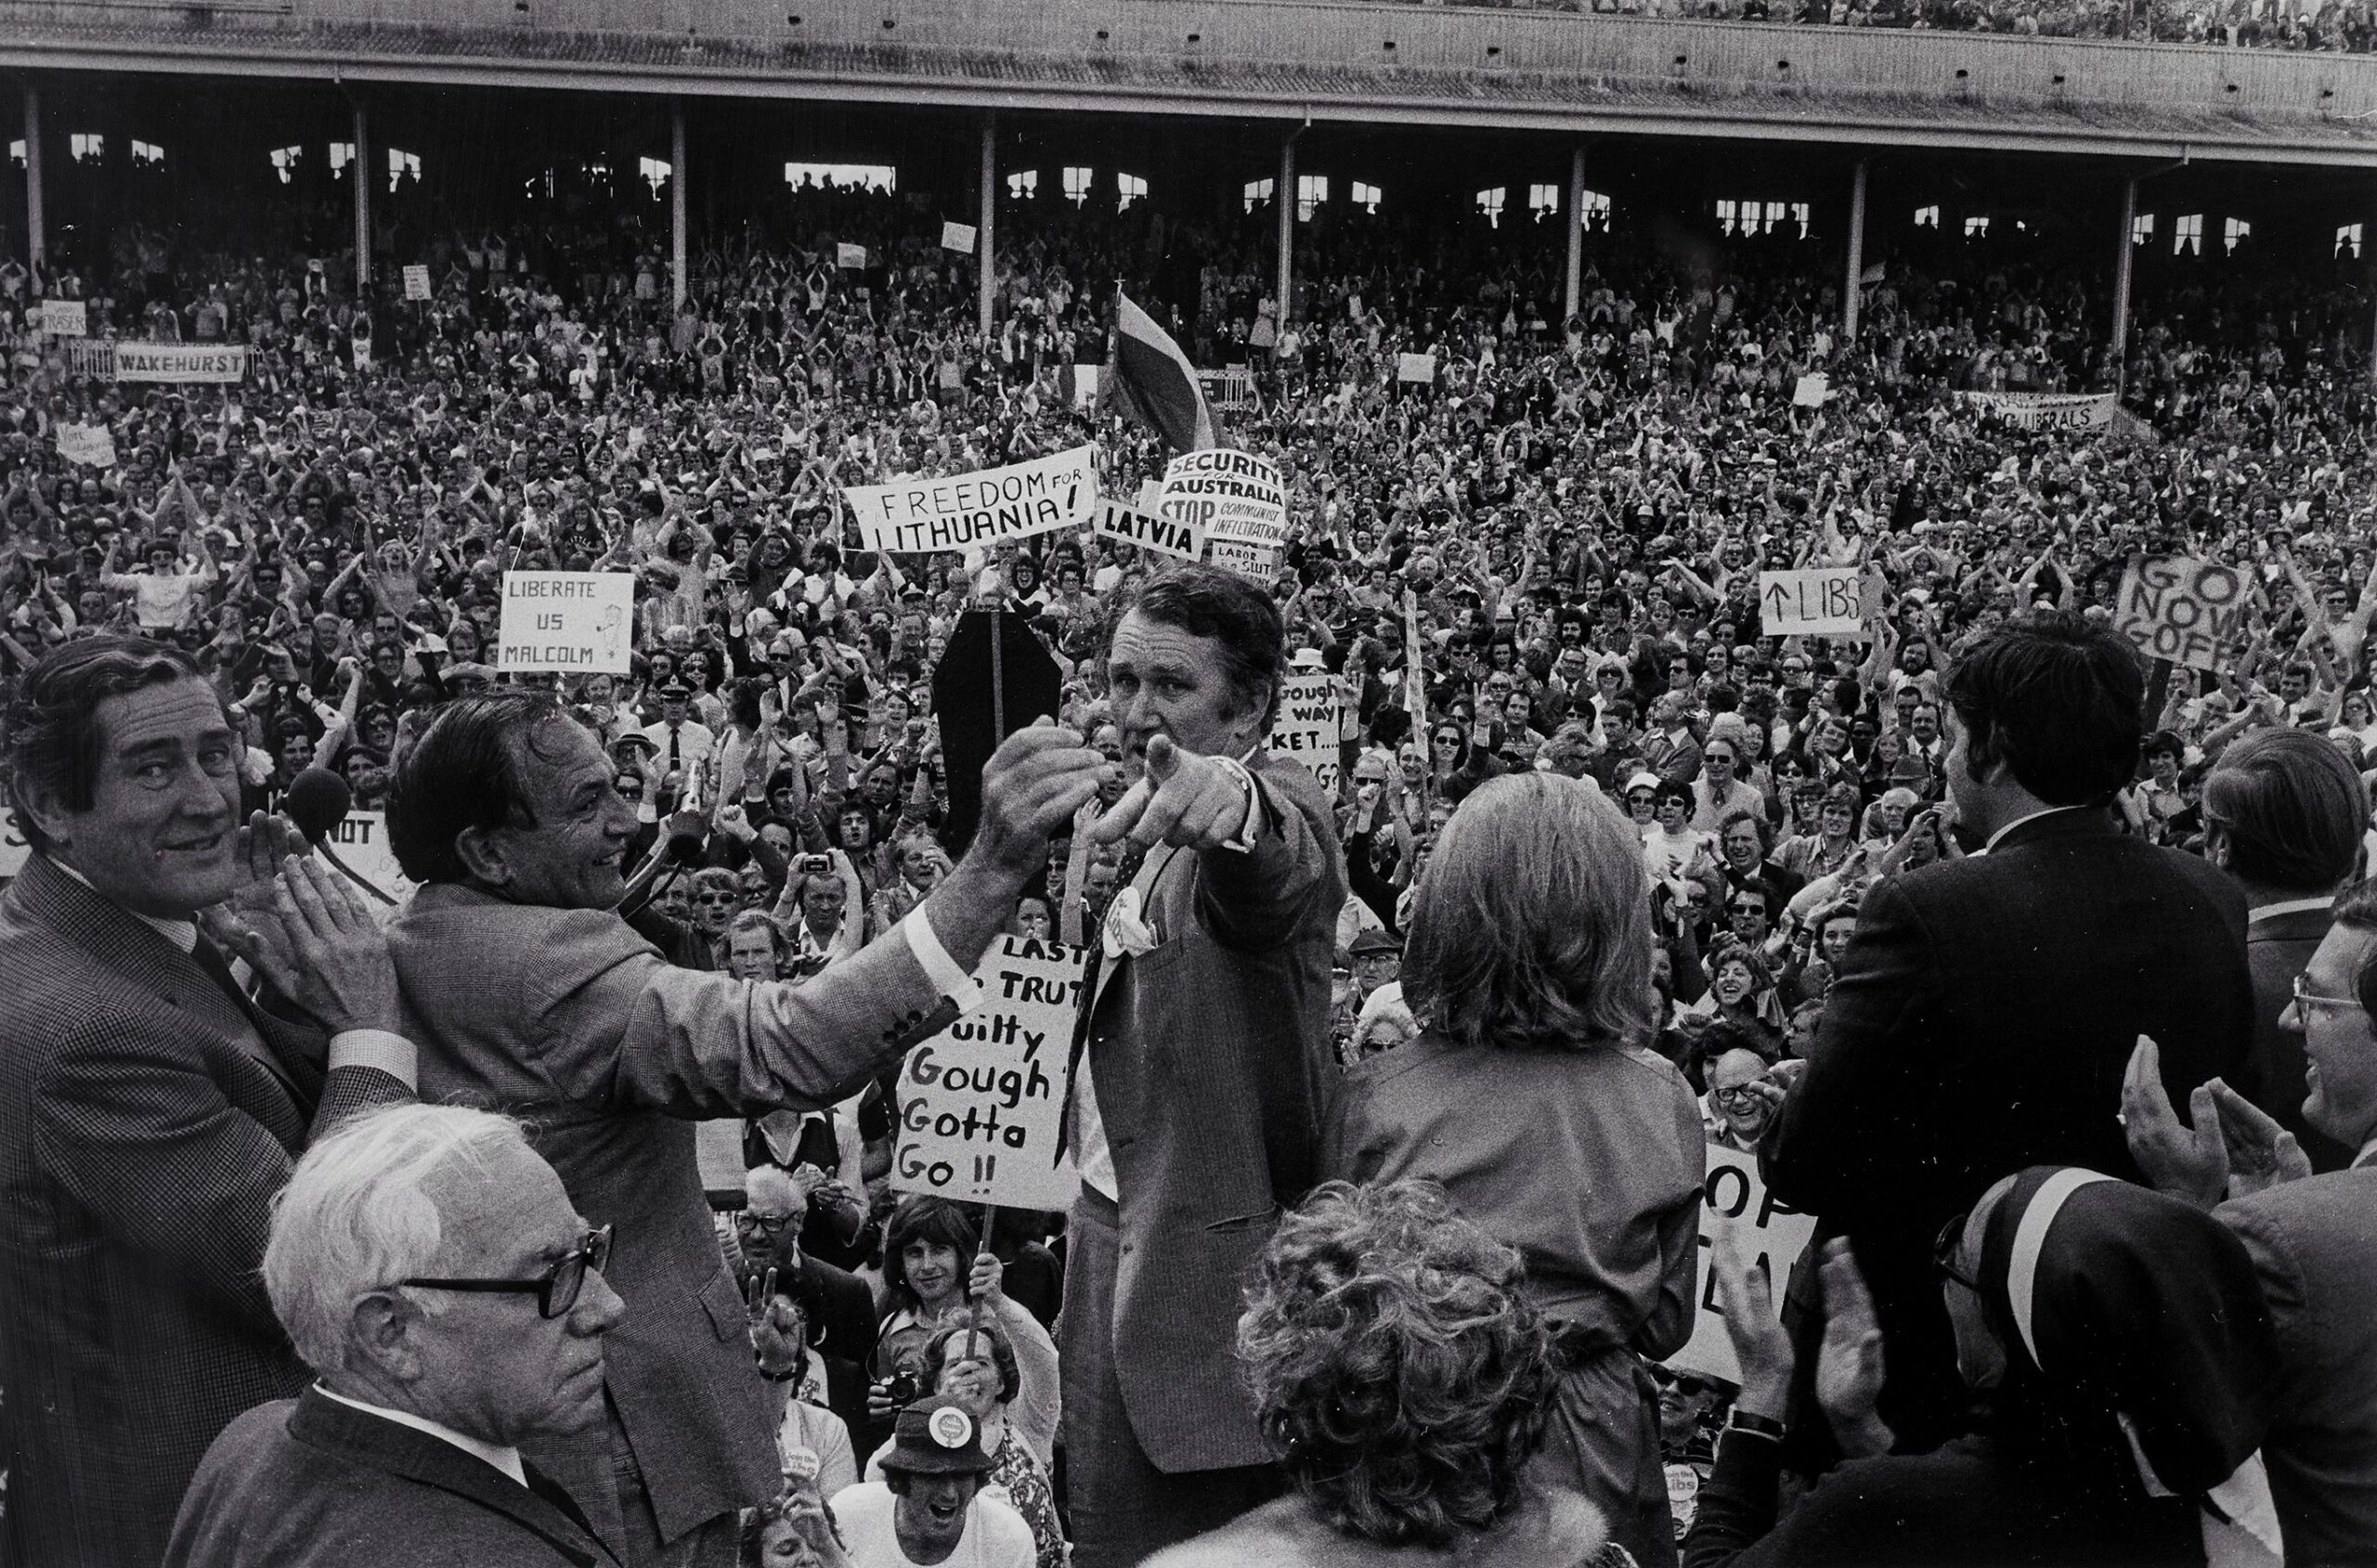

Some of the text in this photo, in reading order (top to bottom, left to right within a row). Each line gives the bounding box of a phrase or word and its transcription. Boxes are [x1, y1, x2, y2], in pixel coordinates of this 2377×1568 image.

[120, 355, 241, 372] WAKEHURST
[1171, 453, 1279, 486] SECURITY
[1202, 472, 1235, 480] FOR
[880, 468, 1083, 520] FREEDOM FOR
[1164, 479, 1283, 508] AUSTRALIA
[875, 484, 1078, 551] LITHUANIA!
[1160, 500, 1215, 527] STOP
[1220, 502, 1280, 522] COMMUNIST
[1104, 506, 1193, 553] LATVIA
[1218, 547, 1257, 561] LABOR
[1241, 561, 1271, 575] SLUT
[510, 580, 596, 598] LIBERATE
[2138, 556, 2240, 605] GO
[1798, 577, 1859, 622] LIBS
[2130, 584, 2241, 641] NOW
[536, 614, 564, 630] US
[505, 645, 593, 664] MALCOLM
[2121, 615, 2230, 667] GOFF
[1292, 705, 1335, 722] WAY
[1264, 730, 1339, 751] KET....
[1002, 936, 1088, 965] LAST
[1000, 970, 1084, 1009] TRUT
[951, 1014, 1046, 1063] uilty
[910, 1046, 1050, 1109] Gough
[902, 1097, 1027, 1148] Gotta
[898, 1143, 955, 1187] Go
[1681, 1470, 1694, 1478] the
